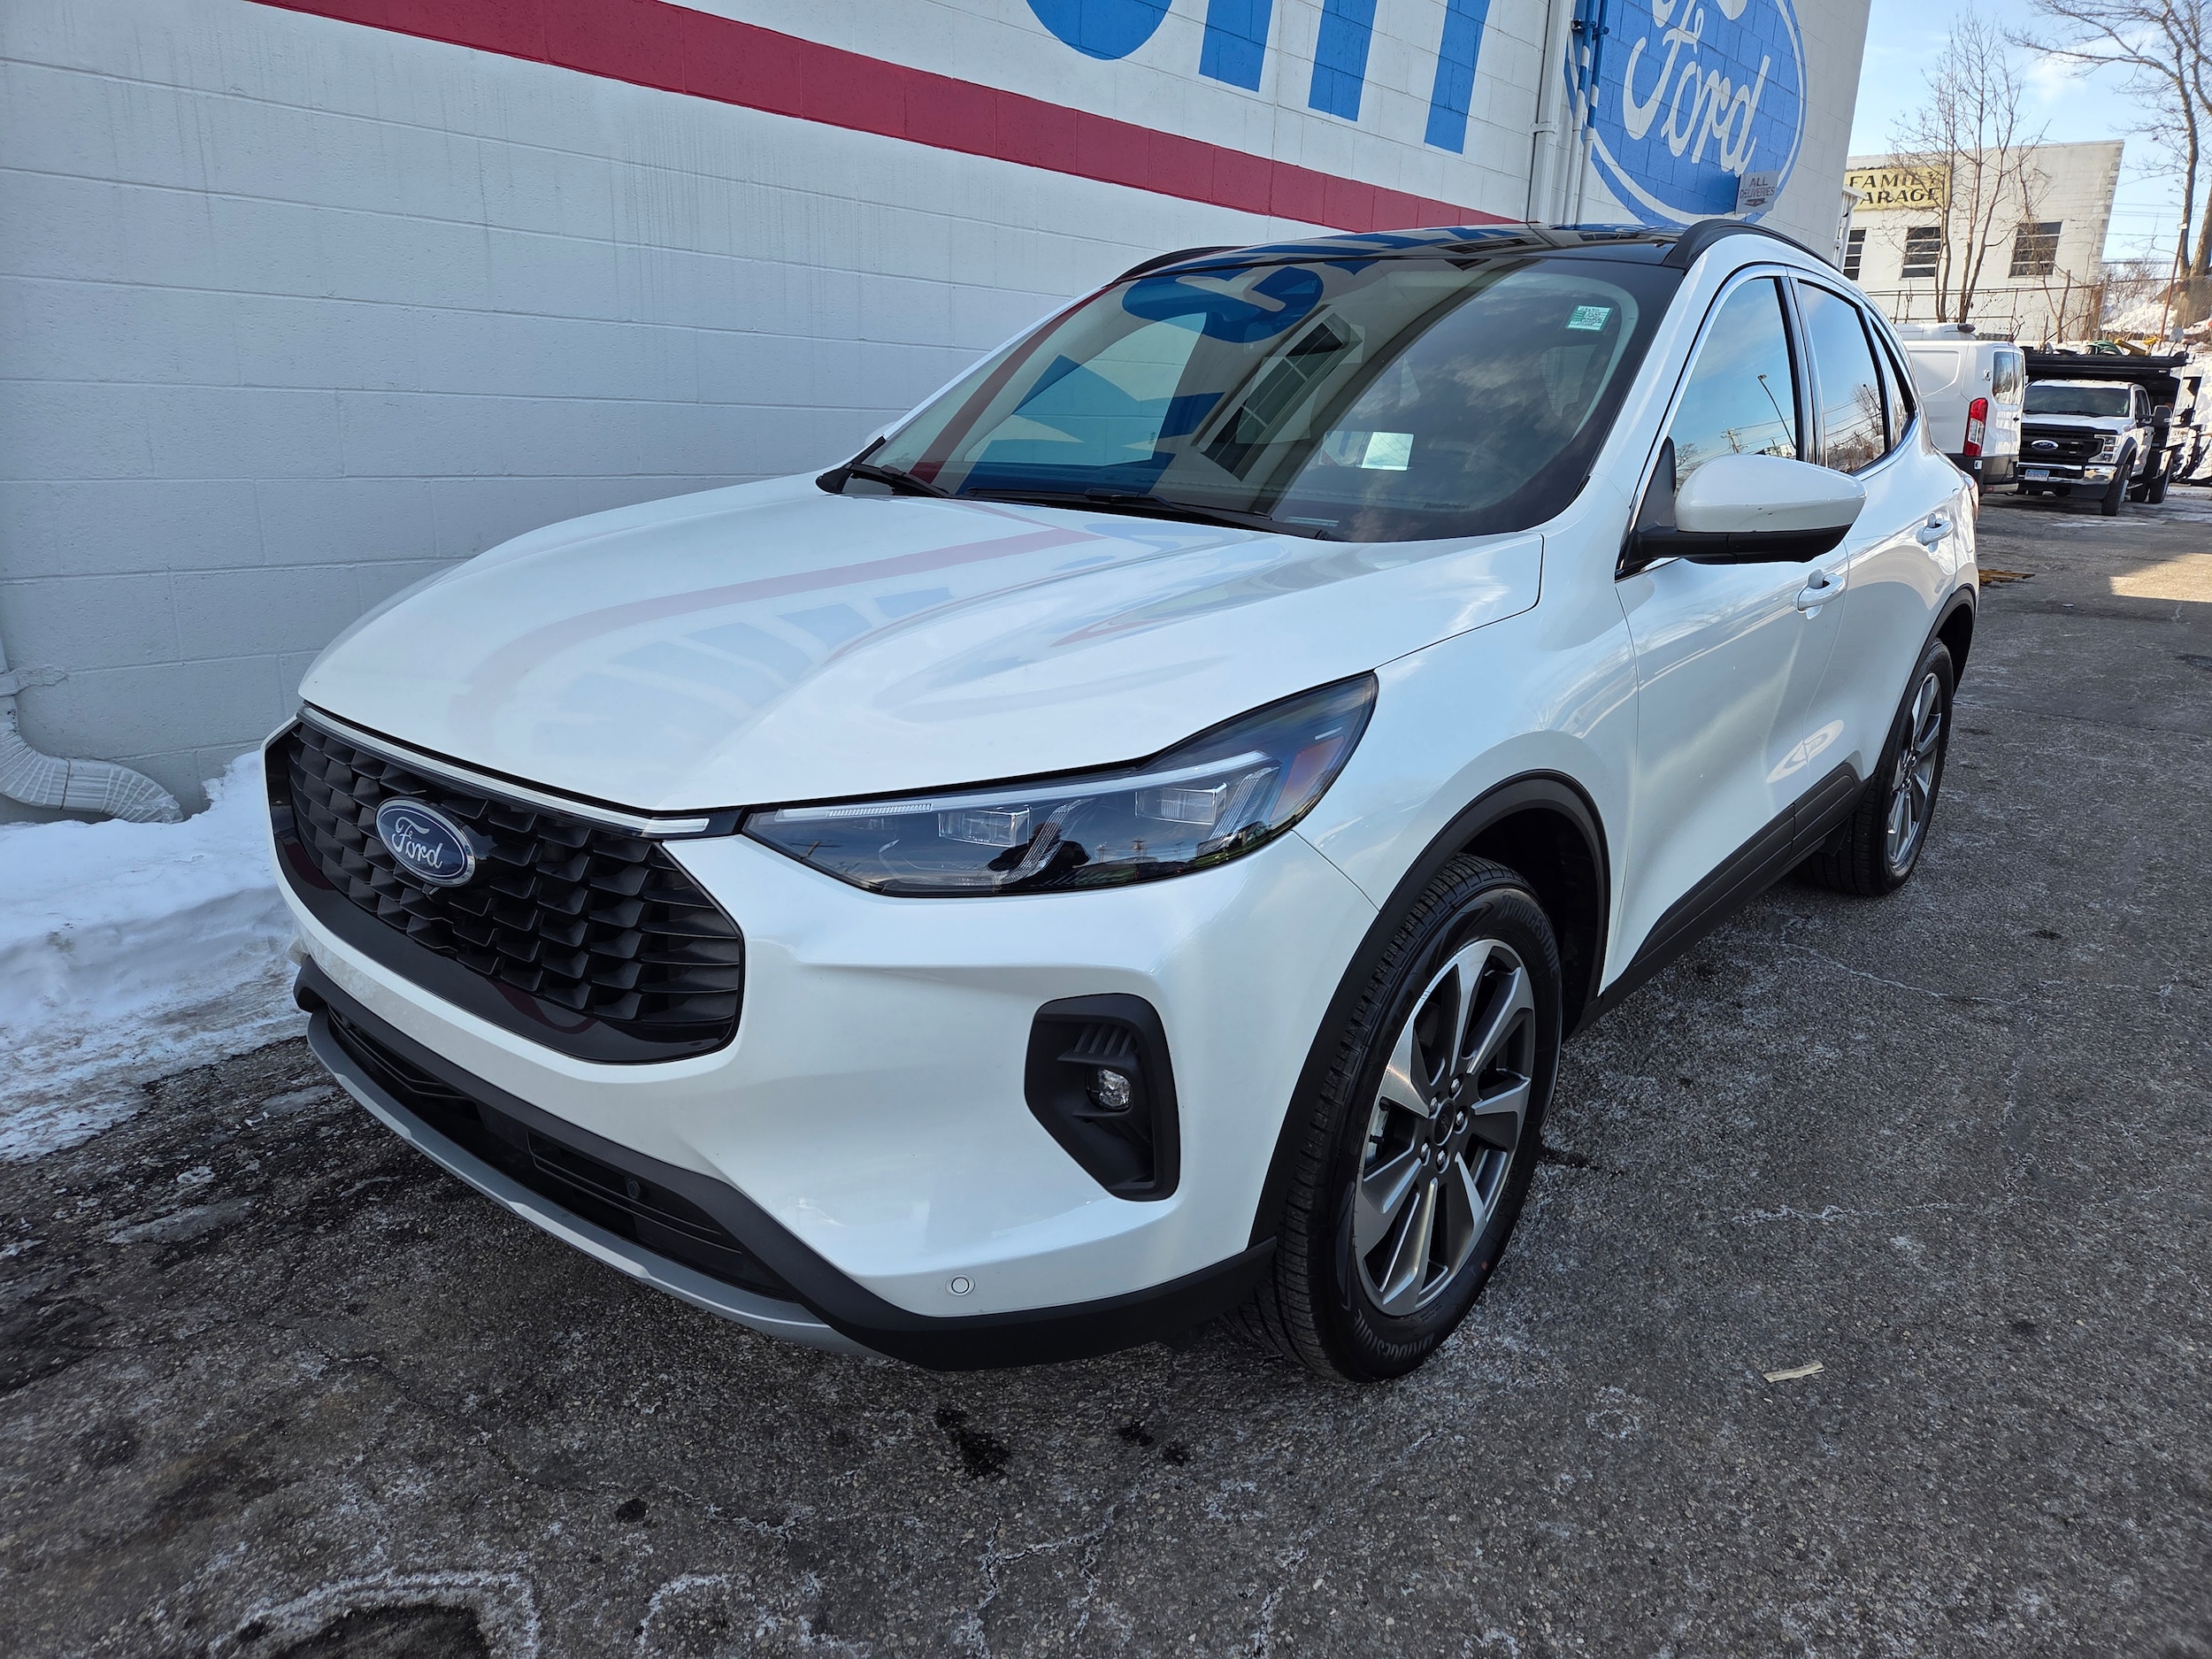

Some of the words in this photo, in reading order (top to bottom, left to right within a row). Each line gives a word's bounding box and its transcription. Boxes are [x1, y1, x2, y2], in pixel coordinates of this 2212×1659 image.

[1623, 0, 1770, 177] Ford
[1740, 186, 1775, 199] DELIVERIES
[1749, 176, 1768, 187] ALL
[1859, 187, 1940, 204] ARAGE
[392, 816, 443, 869] Ford
[1499, 894, 1560, 978] BRIDGESTONE
